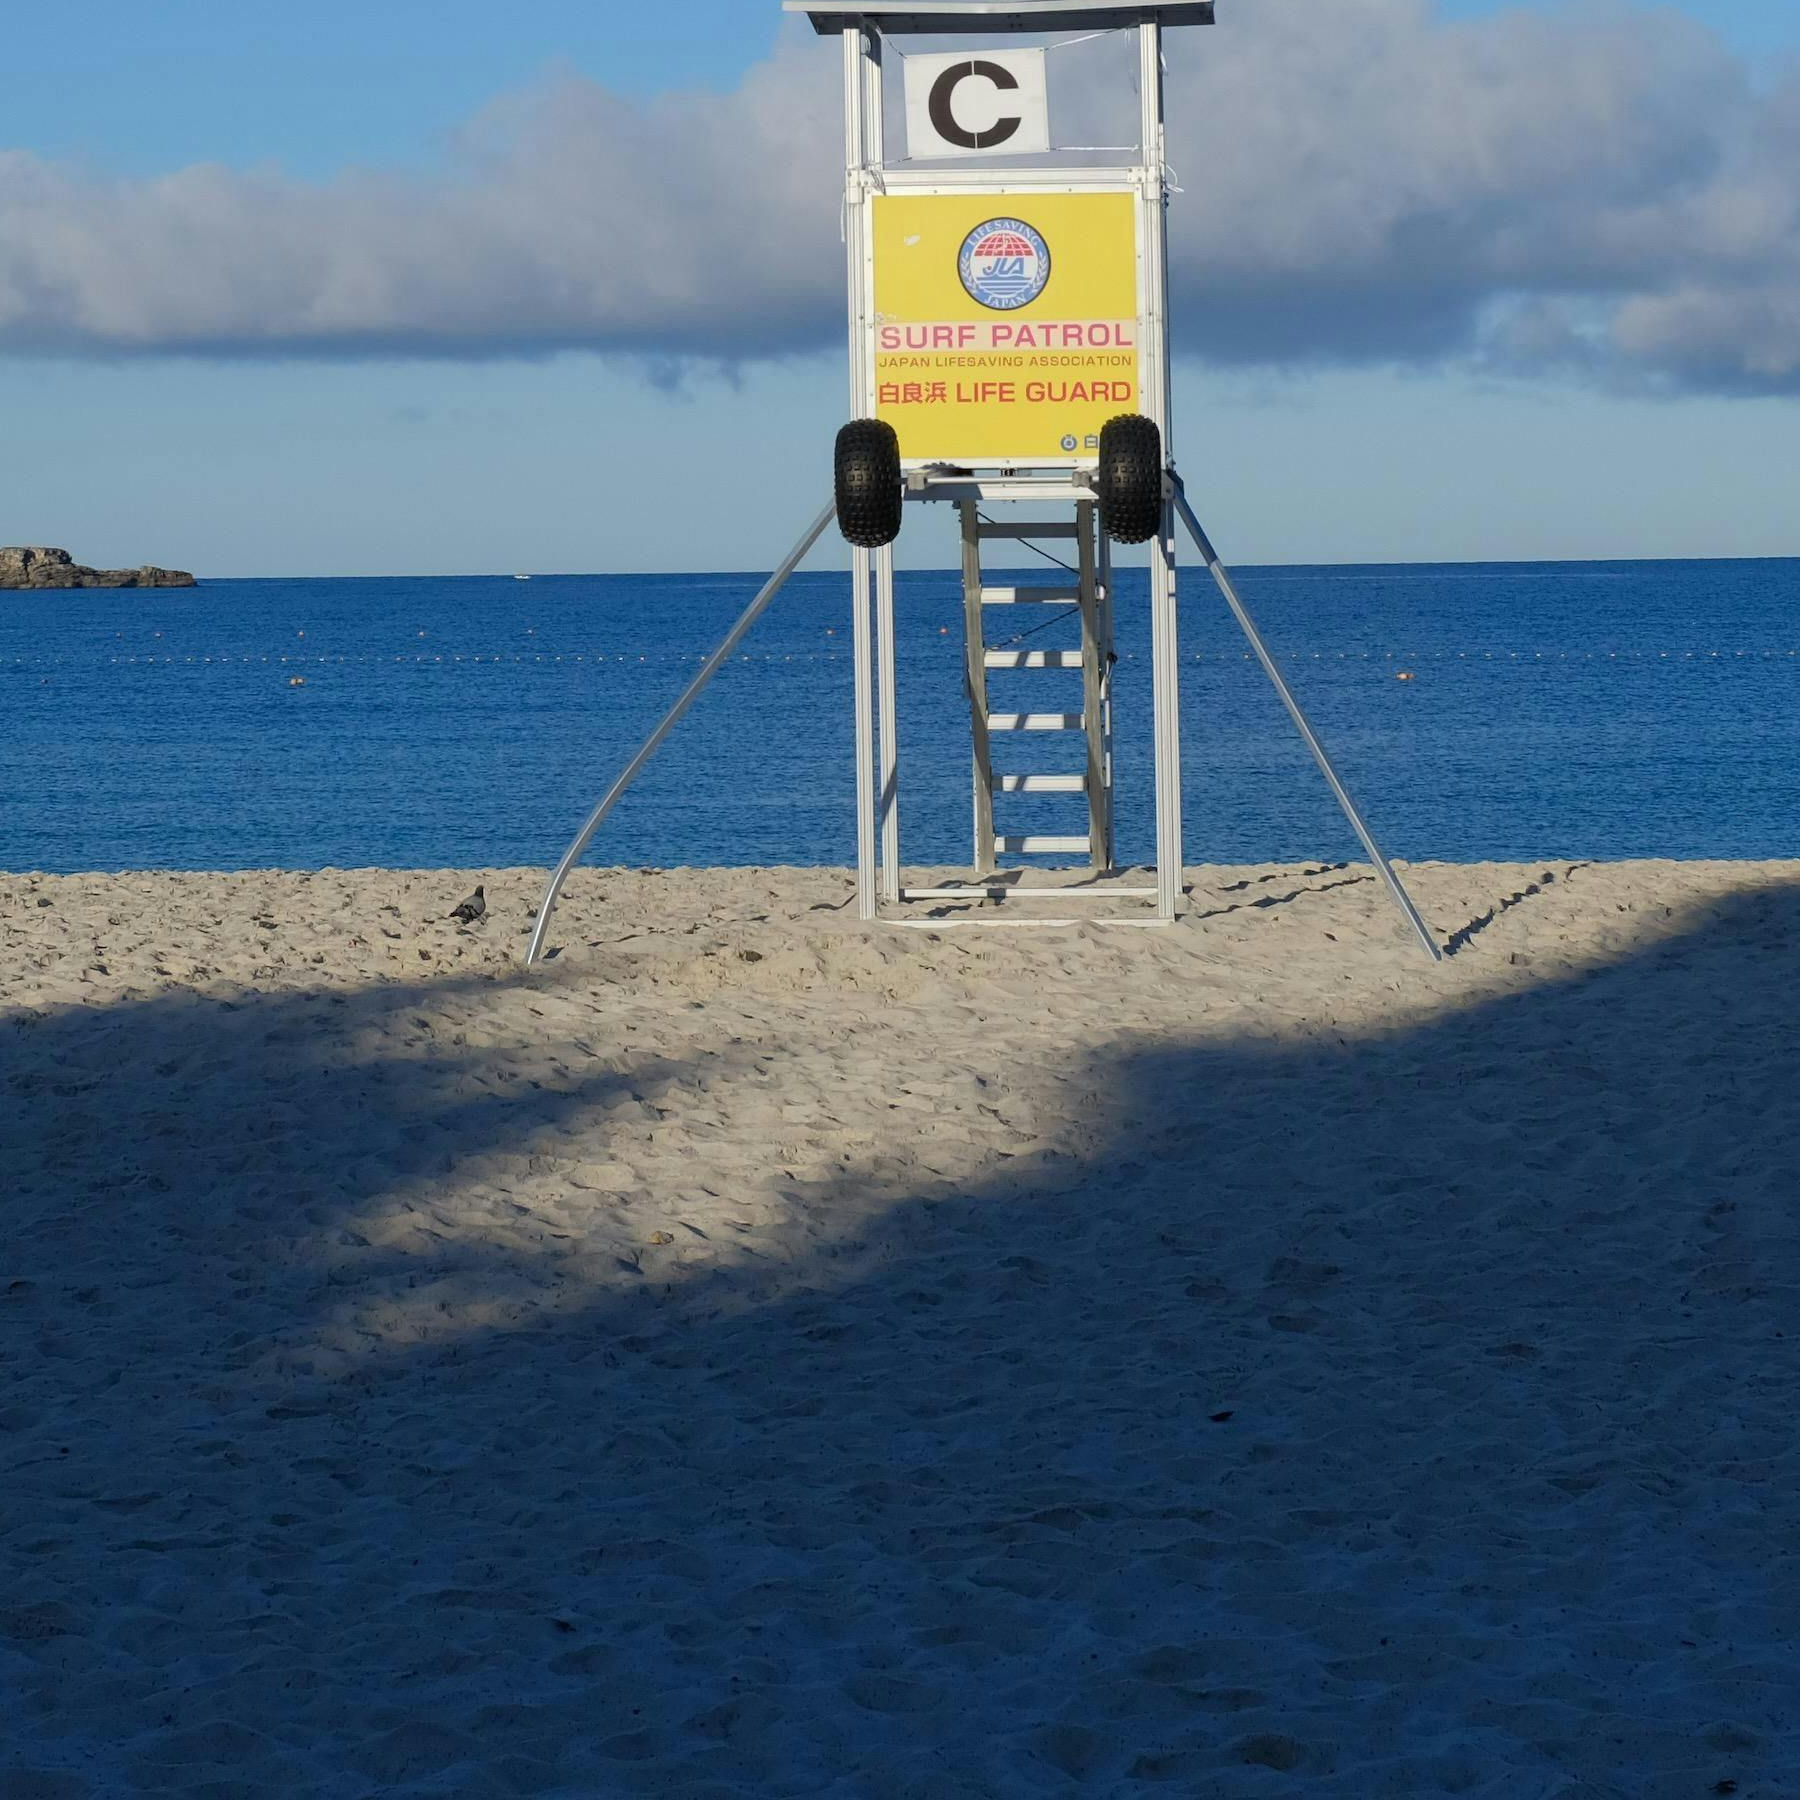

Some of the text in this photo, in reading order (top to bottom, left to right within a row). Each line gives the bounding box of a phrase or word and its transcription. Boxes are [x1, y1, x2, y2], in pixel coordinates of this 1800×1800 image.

[928, 60, 1021, 148] C
[982, 258, 1024, 275] JLA
[984, 296, 1026, 307] JAPAN
[880, 323, 1133, 349] SURF PATROL
[879, 355, 1132, 367] JAPAN LIFESAVING ASSOCIATION
[879, 381, 1132, 404] 白良浜 LIFE GUARD
